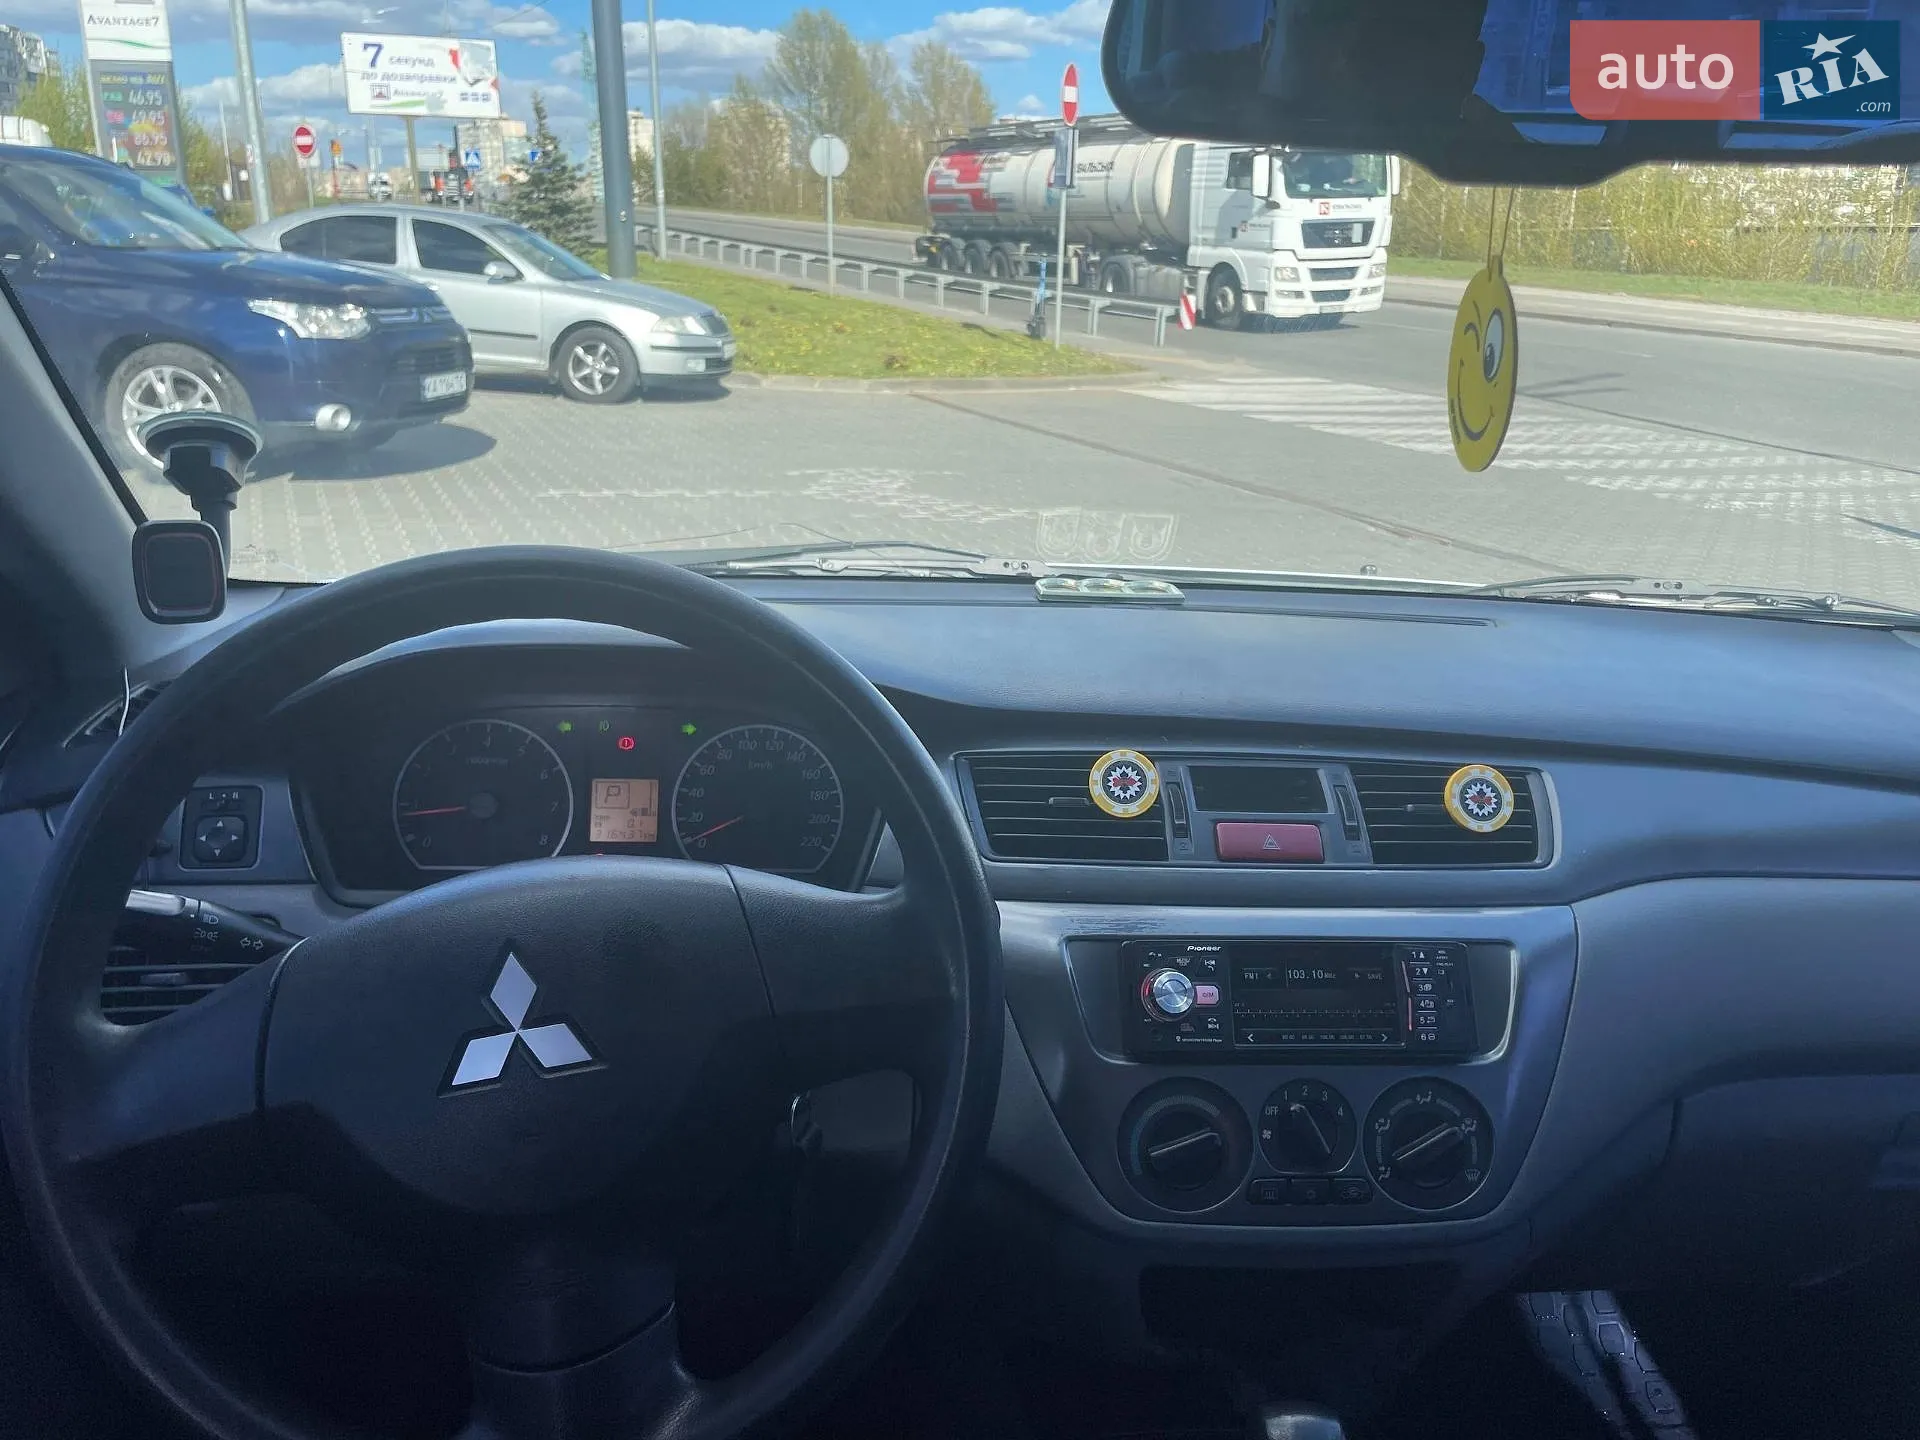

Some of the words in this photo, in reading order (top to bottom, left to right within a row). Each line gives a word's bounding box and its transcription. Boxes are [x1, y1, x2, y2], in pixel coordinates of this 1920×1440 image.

[362, 42, 385, 69] 7
[388, 55, 436, 68] секунд
[738, 740, 758, 751] 100
[765, 741, 784, 752] 120
[716, 750, 732, 760] 80
[785, 750, 807, 763] 140
[700, 765, 716, 776] 60
[801, 769, 821, 780] 160
[604, 785, 621, 804] P
[688, 788, 705, 799] 40
[687, 812, 704, 823] 20
[808, 814, 831, 825] 200
[1415, 968, 1421, 976] 2
[1418, 984, 1424, 992] 3
[1419, 1000, 1425, 1008] 4
[1420, 1016, 1426, 1025] 5
[1302, 1085, 1308, 1096] 2
[1322, 1089, 1328, 1101] 3
[1264, 1106, 1279, 1116] OFF
[1337, 1106, 1343, 1117] 4
